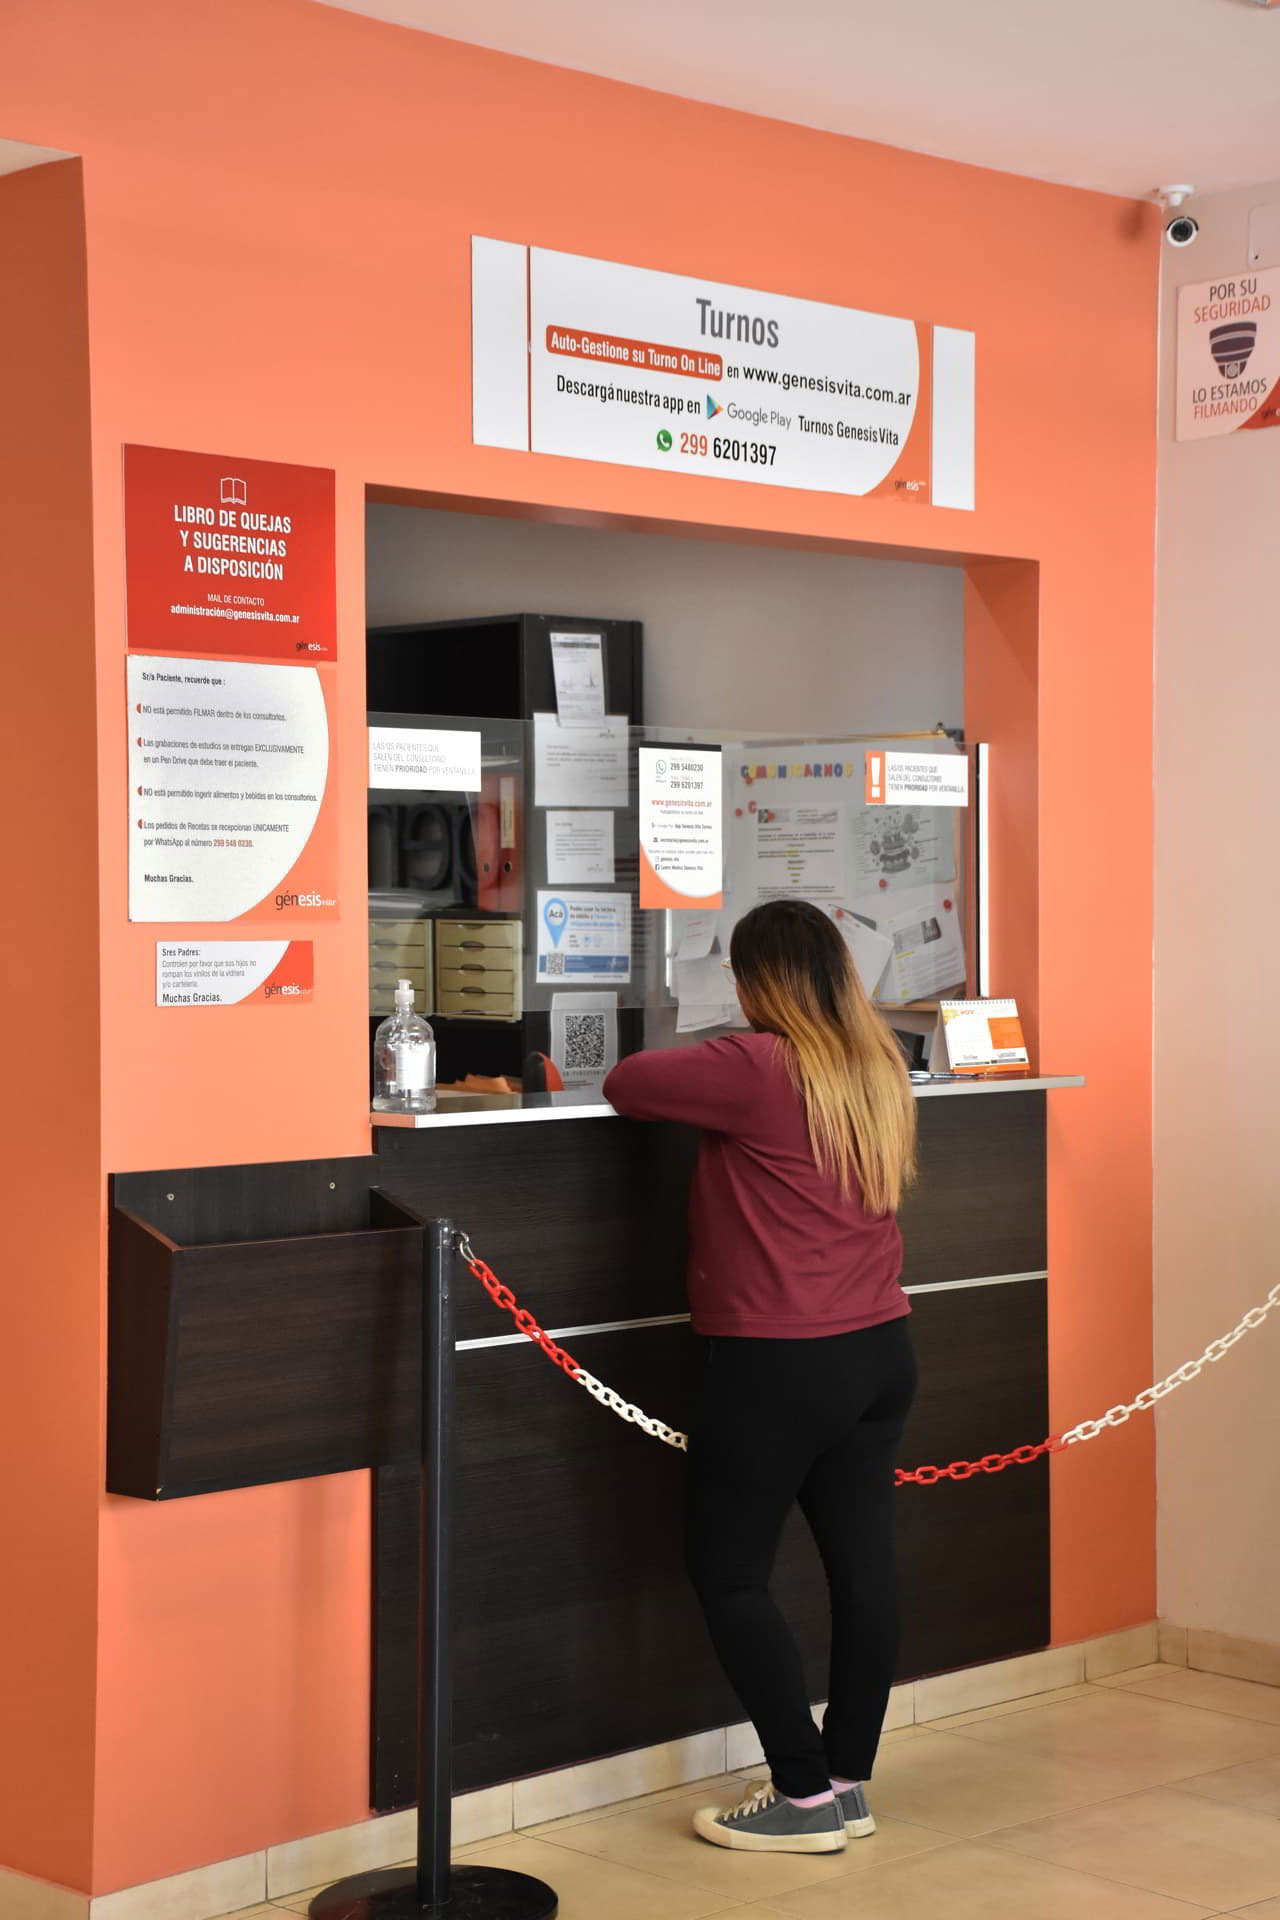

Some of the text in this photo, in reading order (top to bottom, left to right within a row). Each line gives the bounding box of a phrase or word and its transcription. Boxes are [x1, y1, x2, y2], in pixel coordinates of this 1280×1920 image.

[1210, 278, 1257, 302] POR SU
[1194, 295, 1271, 323] SEGURIDAD
[696, 298, 780, 349] Turnos
[551, 332, 911, 406] Auto-Gestione su Turno On Line en www.genesisvita.com.ar
[1192, 378, 1267, 403] LO ESTAMOS
[557, 375, 898, 445] Descargá nuestra app en Google Play Turnos Genesis Vita
[1194, 397, 1257, 420] FILMANDO
[680, 432, 776, 466] 299 6201397
[174, 505, 291, 533] LIBRO DE QUEJAS
[180, 531, 286, 557] Y SUGERENCIAS
[184, 556, 283, 580] A DISPOSICIÓN
[208, 594, 264, 606] MAIL DE CONTACTO
[171, 604, 300, 624] administración@genesisvita.com.ar
[157, 674, 183, 684] Paciente,
[185, 676, 210, 685] recuerde
[143, 705, 151, 714] NO
[153, 707, 165, 715] está
[166, 708, 192, 718] permitido
[194, 709, 215, 717] FILMAR
[217, 710, 234, 718] dentro
[253, 712, 287, 721] consultorios.
[144, 738, 153, 747] Las
[155, 739, 188, 750] grabaciones
[190, 741, 197, 749] de
[199, 742, 221, 750] estudios
[231, 744, 253, 752] entregan
[255, 745, 304, 754] EXCLUSIVAMENTE
[396, 743, 426, 752] PACIENTES
[428, 744, 439, 752] QUE
[161, 756, 171, 764] Pen
[173, 756, 186, 765] Drive
[188, 758, 198, 767] que
[200, 757, 213, 765] debe
[215, 758, 226, 766] traer
[235, 760, 258, 768] paciente.
[373, 752, 392, 760] SALEN
[394, 753, 404, 761] DEL
[374, 764, 394, 772] TIENEN
[395, 765, 427, 773] PRIORIDAD
[670, 763, 680, 771] 299
[144, 788, 152, 796] NO
[154, 788, 165, 796] está
[168, 789, 193, 798] permitido
[195, 789, 212, 799] ingerir
[213, 790, 239, 799] alimentos
[241, 793, 244, 801] y
[245, 792, 266, 800] bebidas
[275, 792, 283, 800] los
[904, 784, 928, 792] PRIORIDAD
[156, 822, 177, 830] pedidos
[179, 822, 186, 830] de
[188, 822, 209, 830] Recetas
[219, 824, 251, 832] recepcionan
[253, 823, 289, 832] UNICAMENTE
[155, 838, 183, 847] WhatsApp
[213, 839, 224, 847] 299
[145, 874, 193, 883] Muchas Gracias.
[276, 891, 321, 910] génesis
[162, 949, 176, 957] Sres
[236, 960, 248, 968] hijos
[212, 969, 218, 977] de
[220, 969, 224, 977] la
[162, 981, 171, 989] y/o
[265, 982, 300, 998] génesis
[162, 993, 222, 1003] Muchas Gracias.
